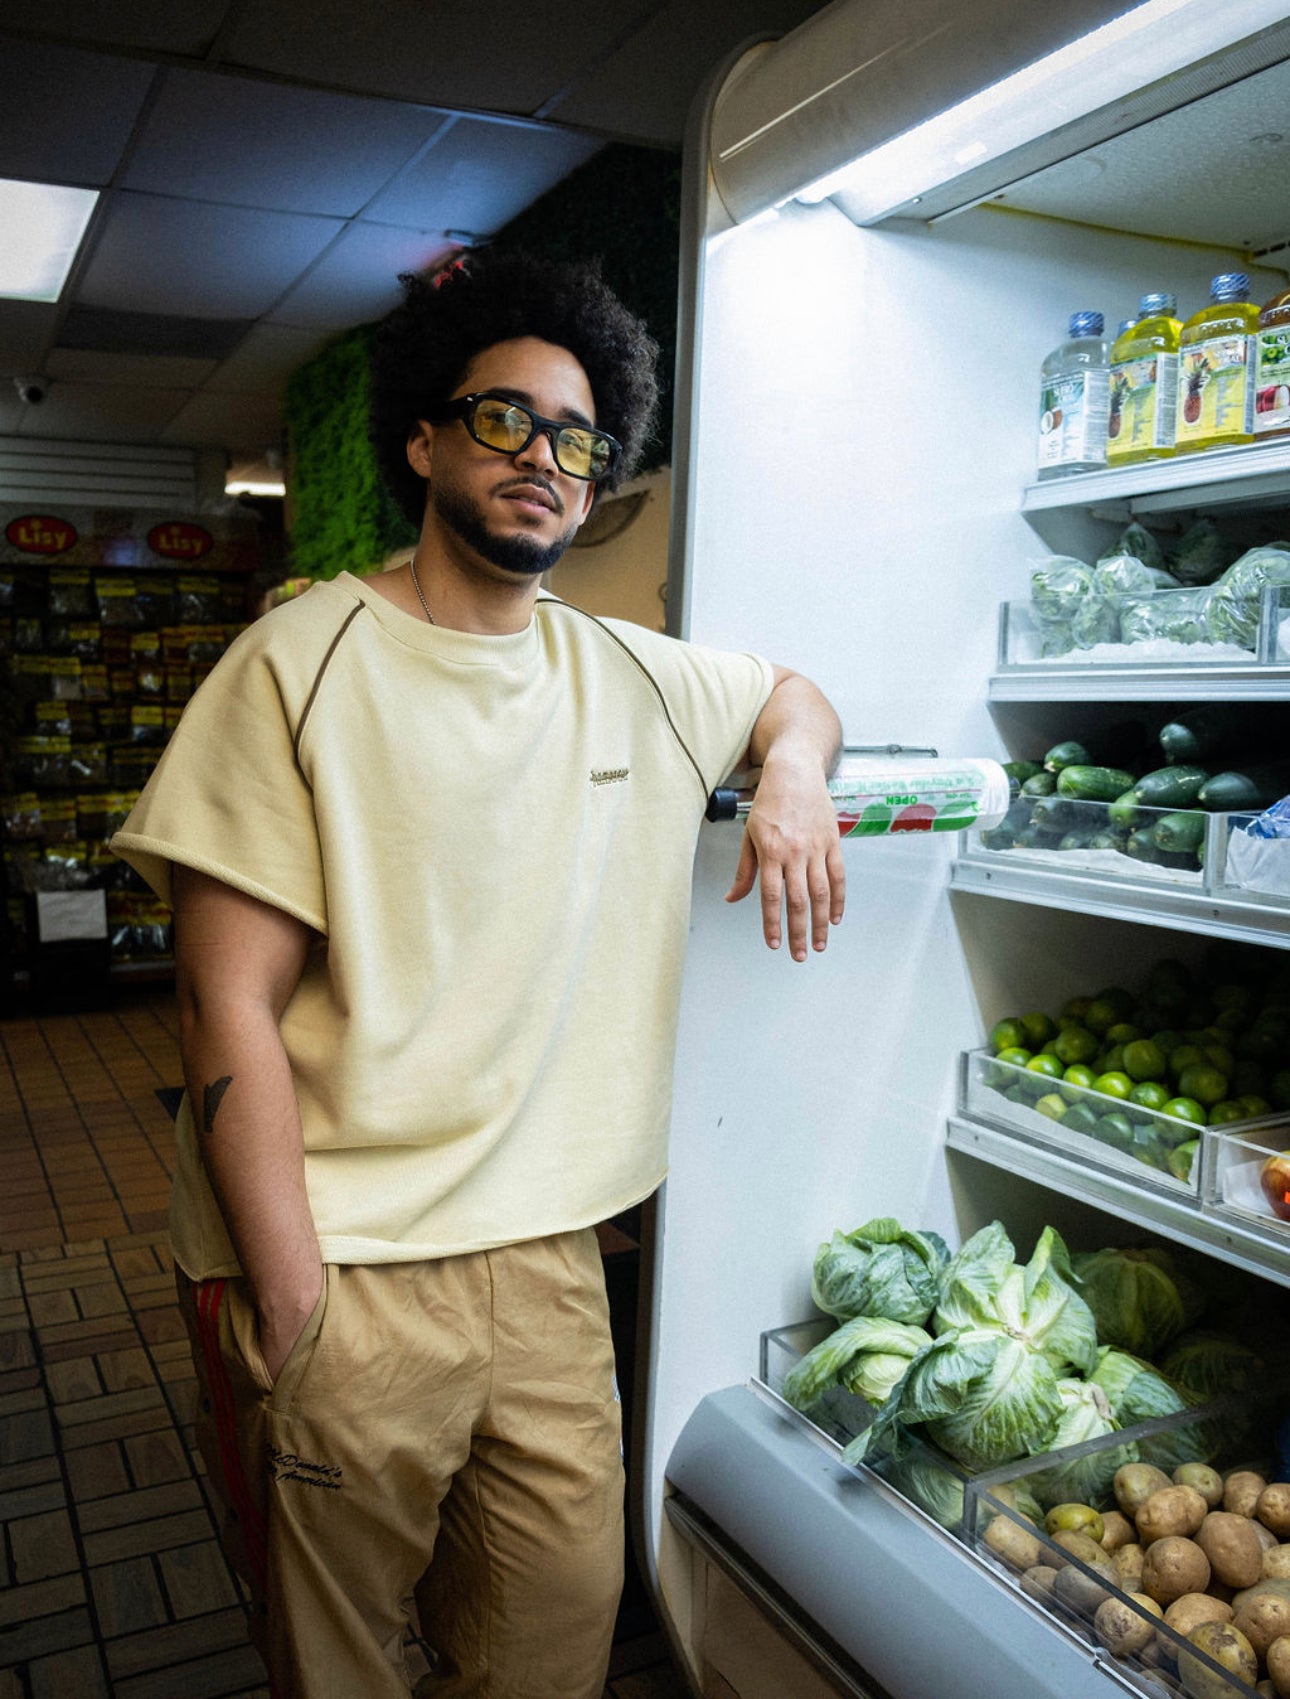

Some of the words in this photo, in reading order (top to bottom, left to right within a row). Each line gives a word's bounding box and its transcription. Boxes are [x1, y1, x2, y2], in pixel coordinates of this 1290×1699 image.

[18, 520, 68, 549] Lisy
[158, 526, 204, 554] Lisy
[887, 796, 918, 805] OPEN
